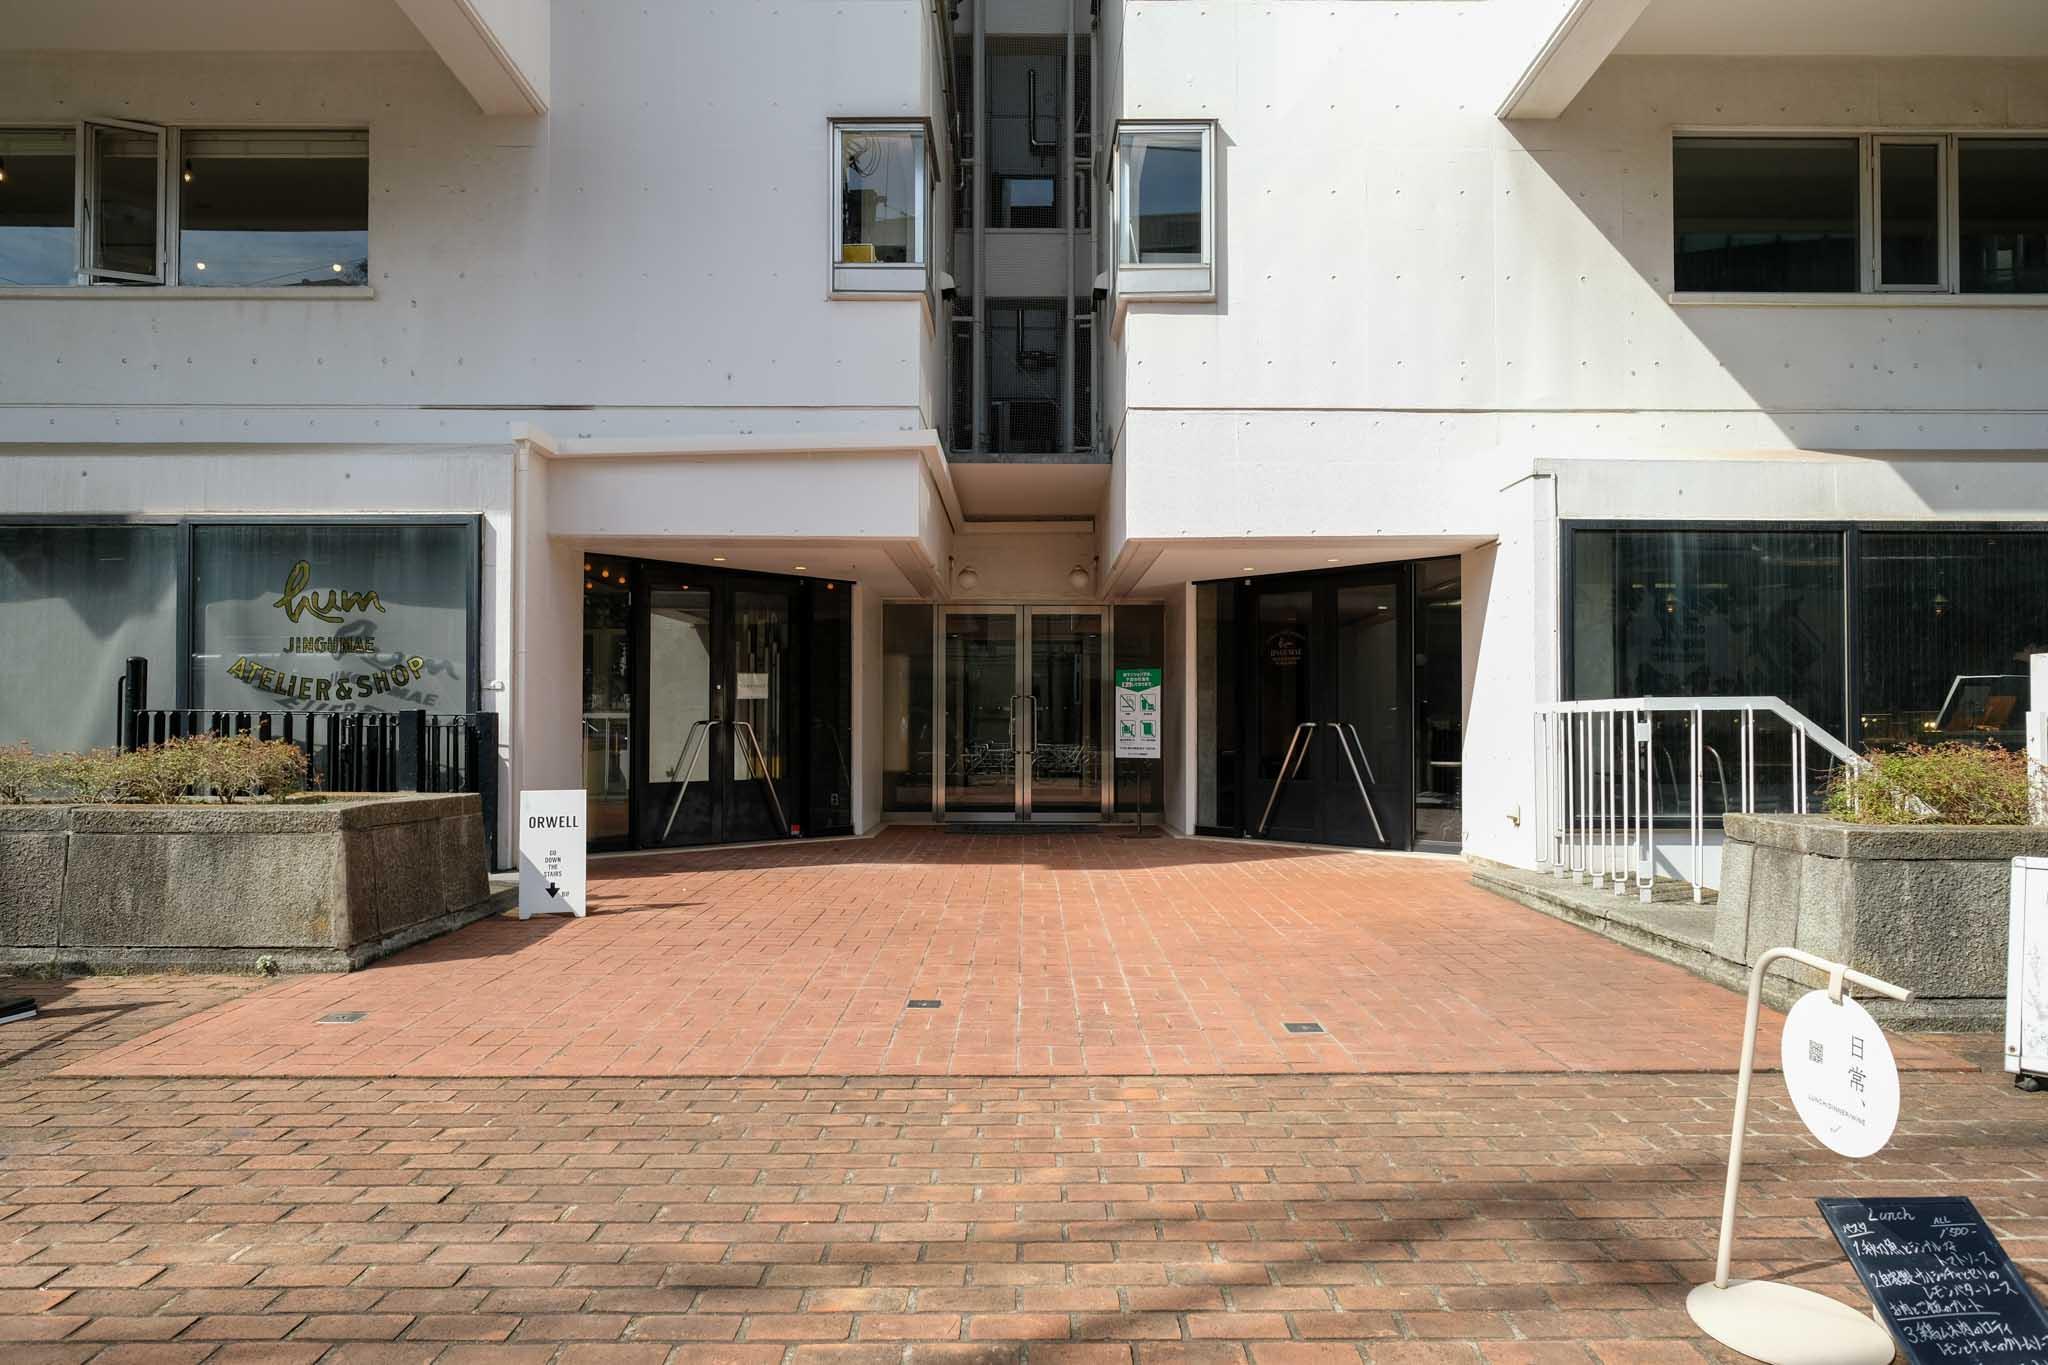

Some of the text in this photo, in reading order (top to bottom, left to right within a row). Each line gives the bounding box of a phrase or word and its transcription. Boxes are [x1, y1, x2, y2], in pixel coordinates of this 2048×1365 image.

[273, 560, 386, 623] hum
[284, 636, 376, 653] JINGUMAE
[528, 815, 579, 829] ORWELL
[1868, 1207, 1917, 1221] Lunch
[1933, 1216, 1951, 1224] ALL
[1934, 1251, 1997, 1266] トマトソース
